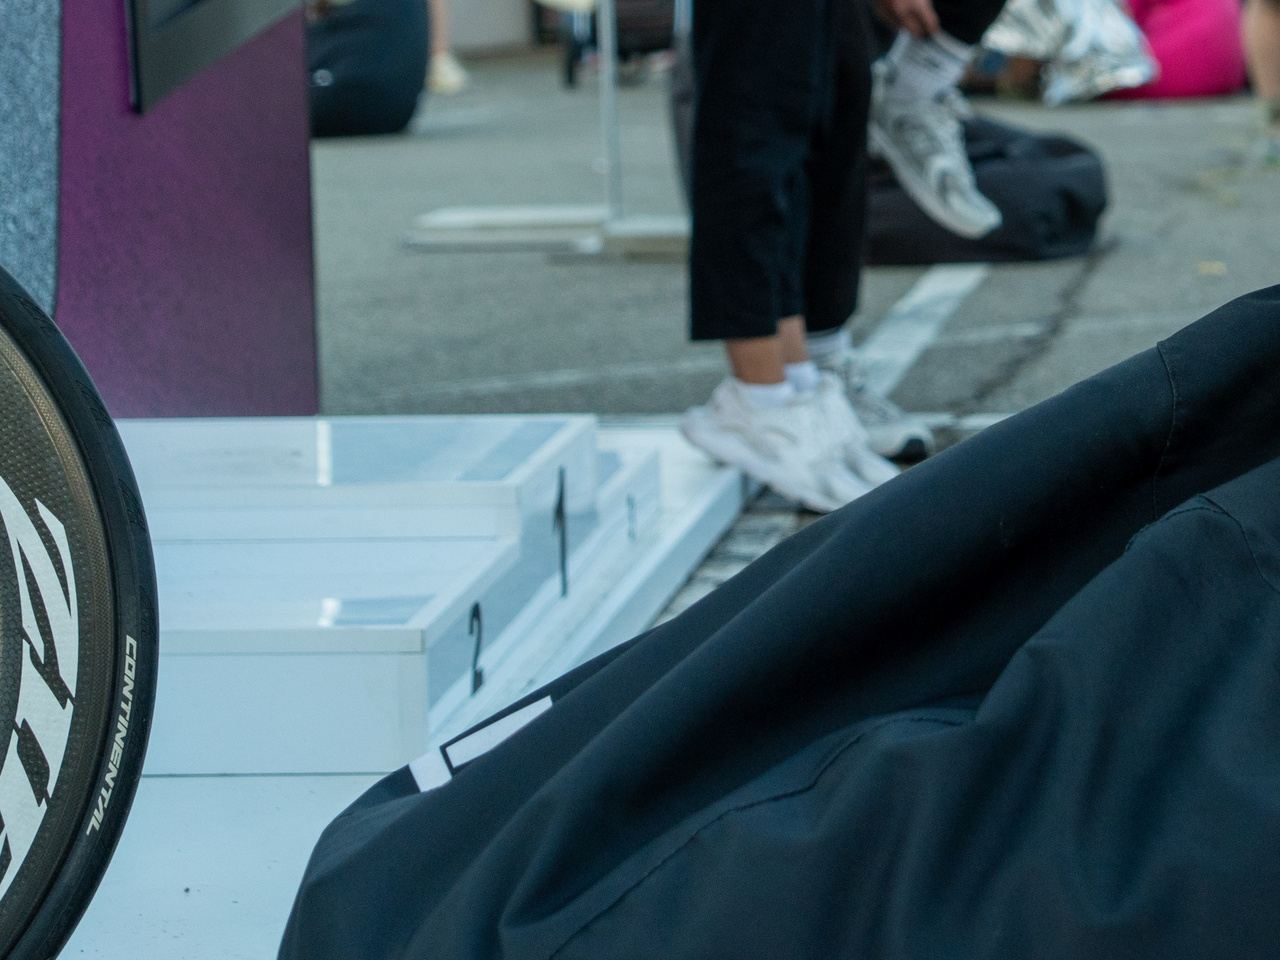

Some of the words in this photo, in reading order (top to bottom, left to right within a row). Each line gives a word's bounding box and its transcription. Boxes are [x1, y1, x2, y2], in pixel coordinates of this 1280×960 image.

[553, 464, 568, 597] 1
[468, 601, 484, 696] 2
[86, 635, 137, 836] CONTINENTAL
